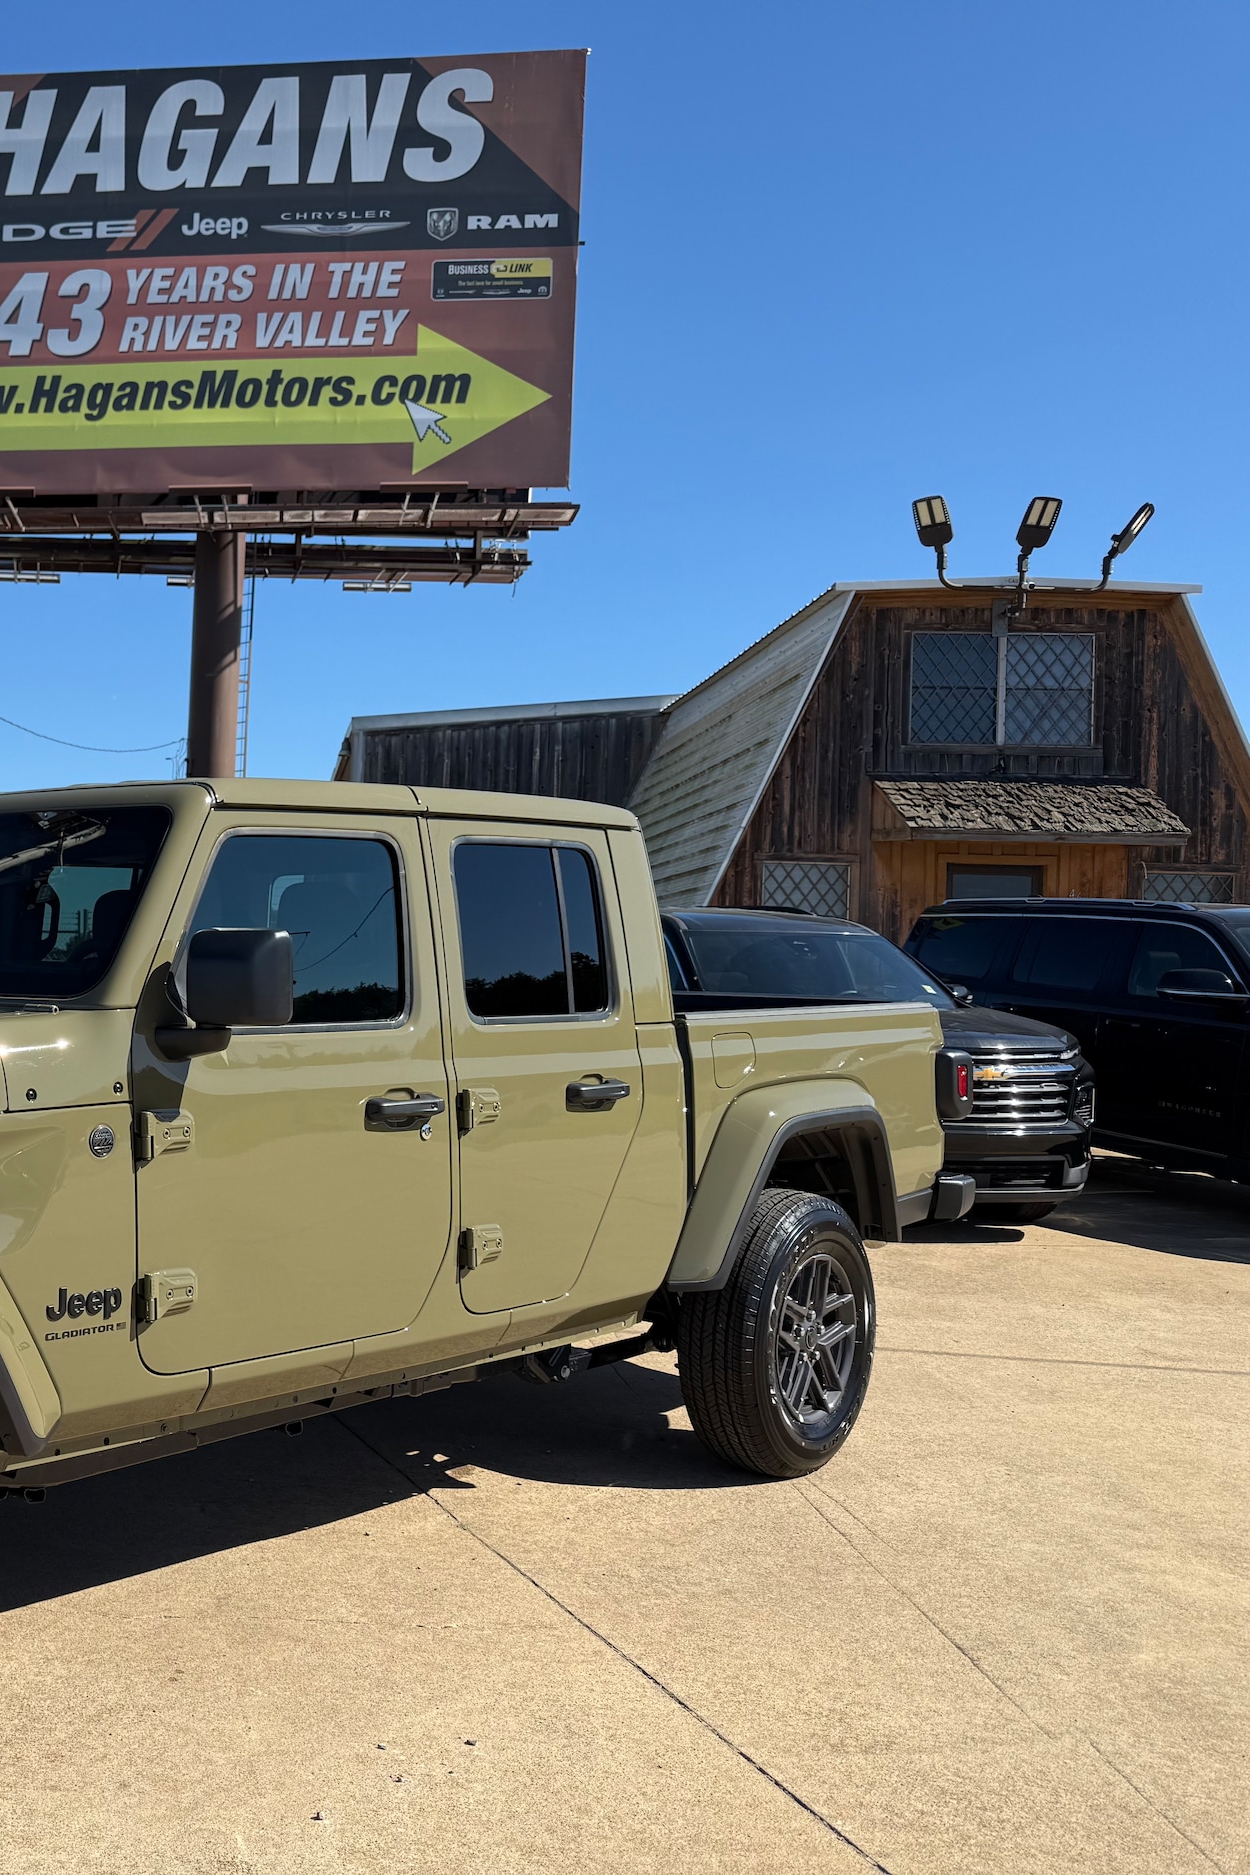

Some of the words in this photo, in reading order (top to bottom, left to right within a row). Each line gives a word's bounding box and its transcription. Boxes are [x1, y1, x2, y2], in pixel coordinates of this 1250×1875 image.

[181, 212, 249, 240] Jeep
[280, 209, 392, 222] CHRYSLER
[467, 213, 559, 231] RAM
[448, 264, 489, 275] BUSINESS
[509, 263, 533, 273] LINK
[124, 263, 256, 306] YEARS
[266, 261, 315, 301] IN
[325, 259, 408, 299] THE
[117, 313, 242, 355] RIVER
[254, 308, 411, 349] VALLEY
[45, 1286, 122, 1322] Jeep
[45, 1324, 114, 1341] GLADIATOR
